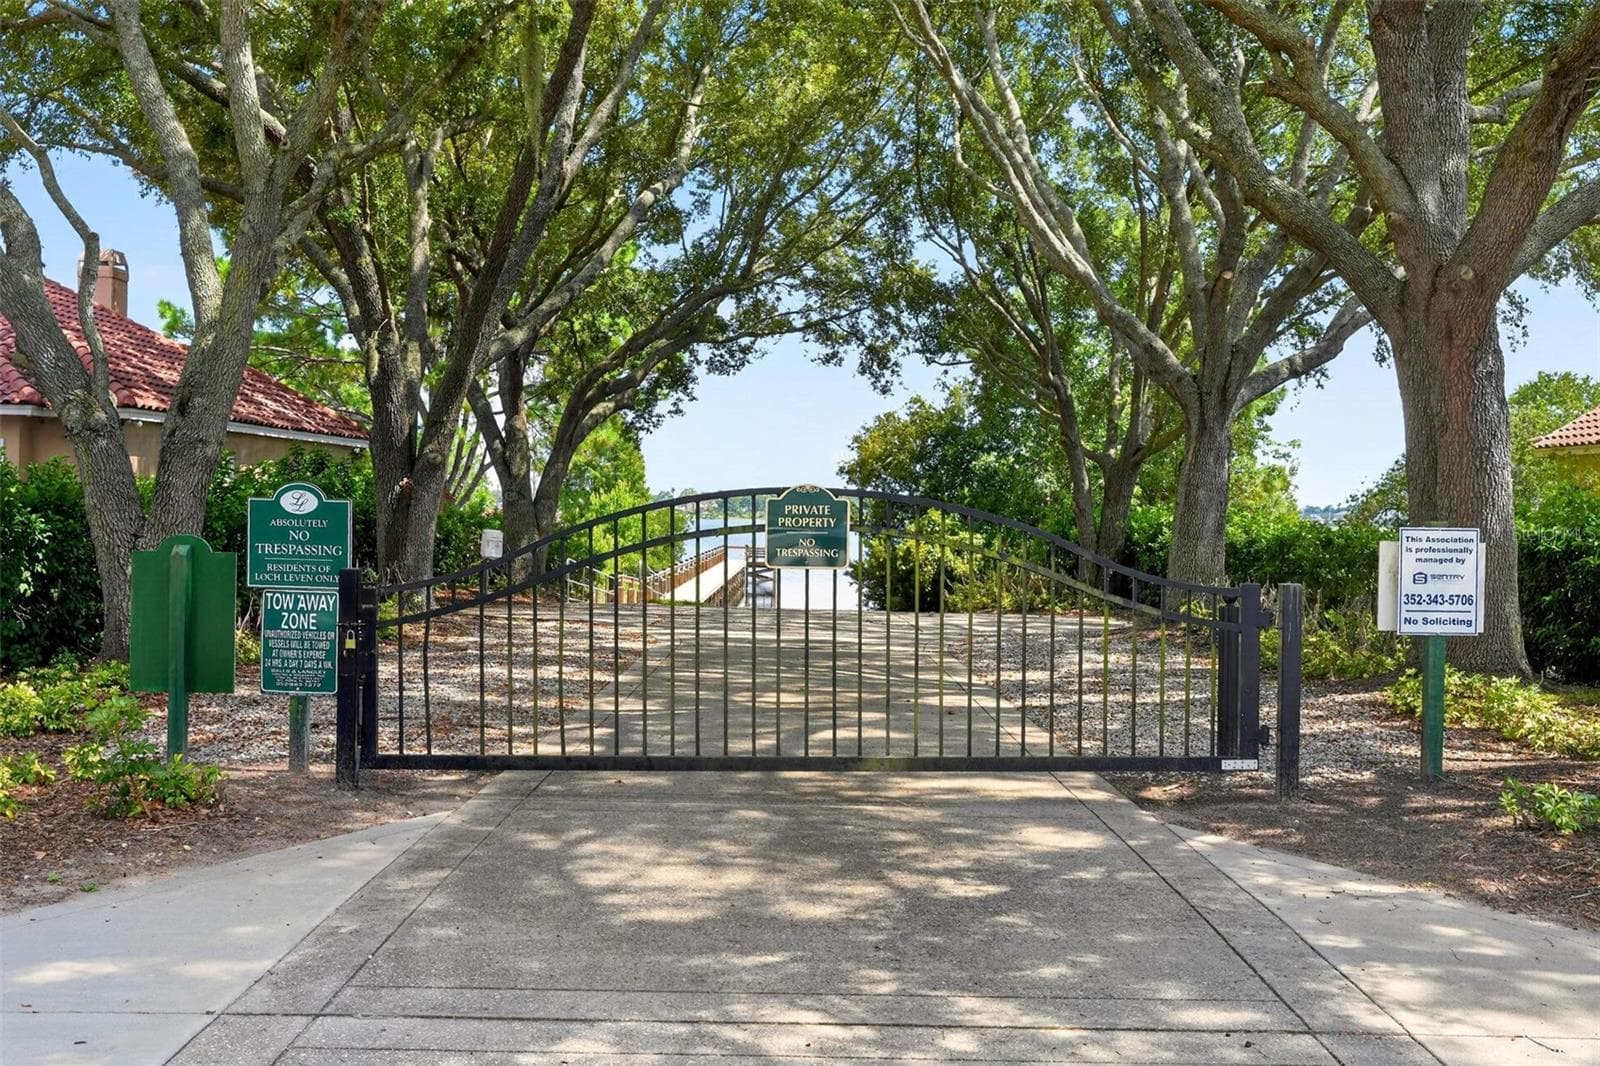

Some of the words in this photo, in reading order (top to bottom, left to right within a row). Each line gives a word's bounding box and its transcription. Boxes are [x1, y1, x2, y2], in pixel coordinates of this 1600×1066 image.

[784, 504, 831, 515] PRIVATE
[269, 519, 329, 528] ABSOLUTELY
[778, 517, 837, 528] PROPERTY
[289, 530, 310, 541] NO
[1405, 535, 1423, 543] This
[1425, 536, 1474, 544] Association
[799, 538, 816, 547] NO
[255, 543, 343, 556] TRESPASSING
[776, 548, 839, 558] TRESPASSING
[1415, 546, 1474, 555] professionally
[1415, 557, 1454, 565] managed
[1455, 557, 1466, 565] by
[266, 563, 317, 573] RESIDENTS
[318, 565, 331, 573] OF
[255, 573, 281, 581] LOCH
[283, 574, 313, 583] LEVEN
[315, 575, 340, 584] ONLY
[265, 593, 295, 610] TOW
[297, 594, 336, 612] AWAY
[1403, 594, 1474, 606] 352-343-5706
[281, 612, 318, 630] ZONE
[1403, 617, 1419, 625] No
[1422, 617, 1473, 627] Soliciting
[264, 629, 301, 639] UNAUTHORIZED
[302, 630, 327, 640] VEHICLES
[268, 639, 290, 649] VESSELS
[312, 640, 330, 650] TOWED
[303, 650, 327, 660] EXPENSE
[288, 659, 299, 668] DAY
[303, 660, 318, 669] DAYS
